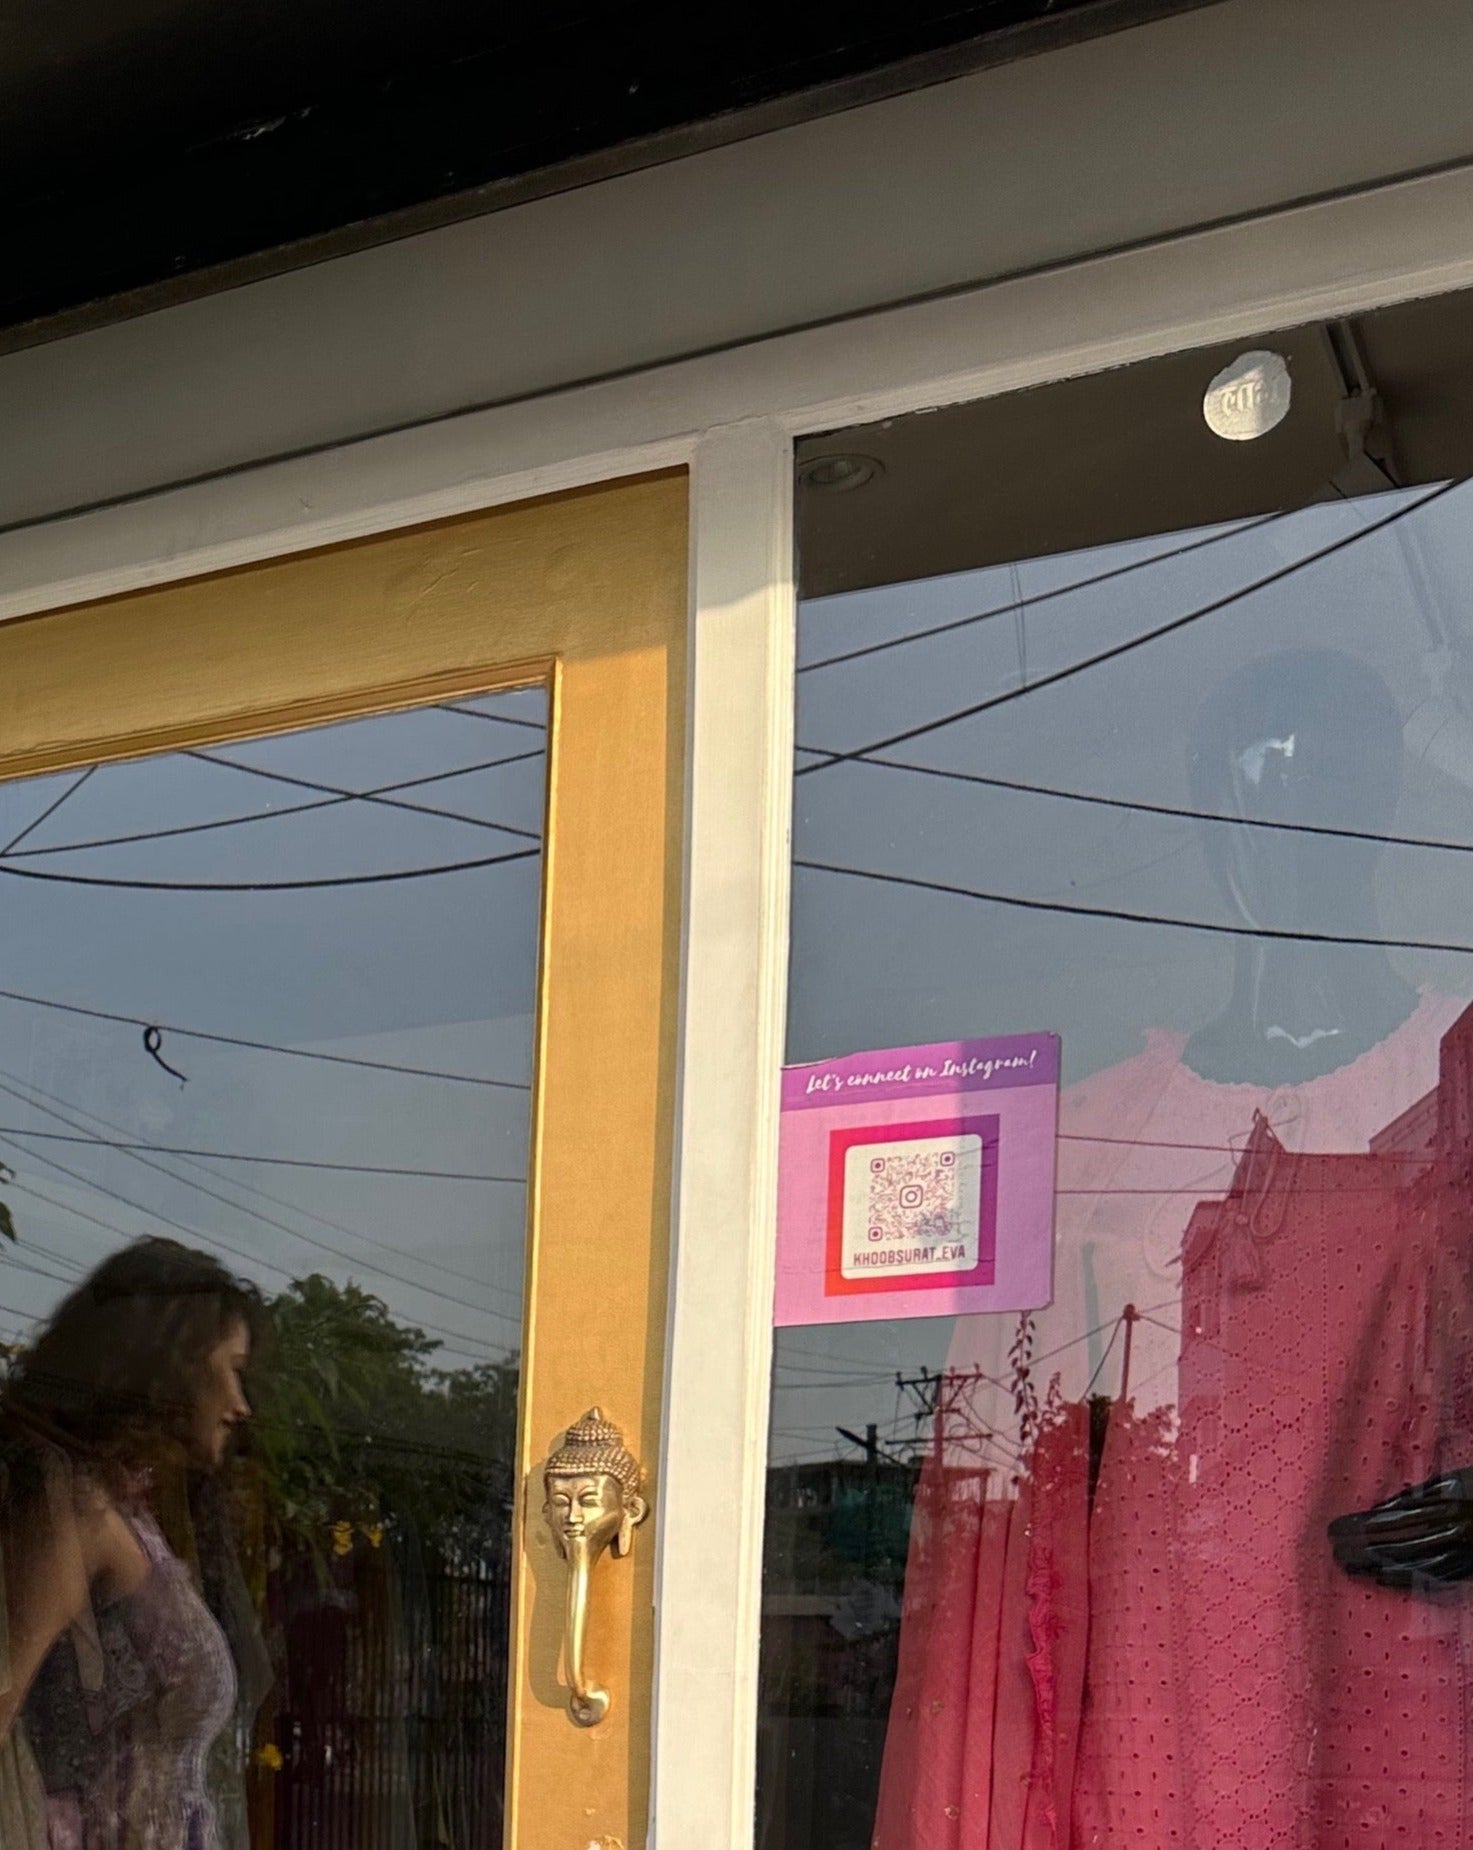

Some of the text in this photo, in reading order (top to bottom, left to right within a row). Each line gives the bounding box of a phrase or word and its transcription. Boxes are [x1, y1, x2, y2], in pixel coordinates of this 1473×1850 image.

[806, 1049, 1037, 1095] Let's connect on Instagram!
